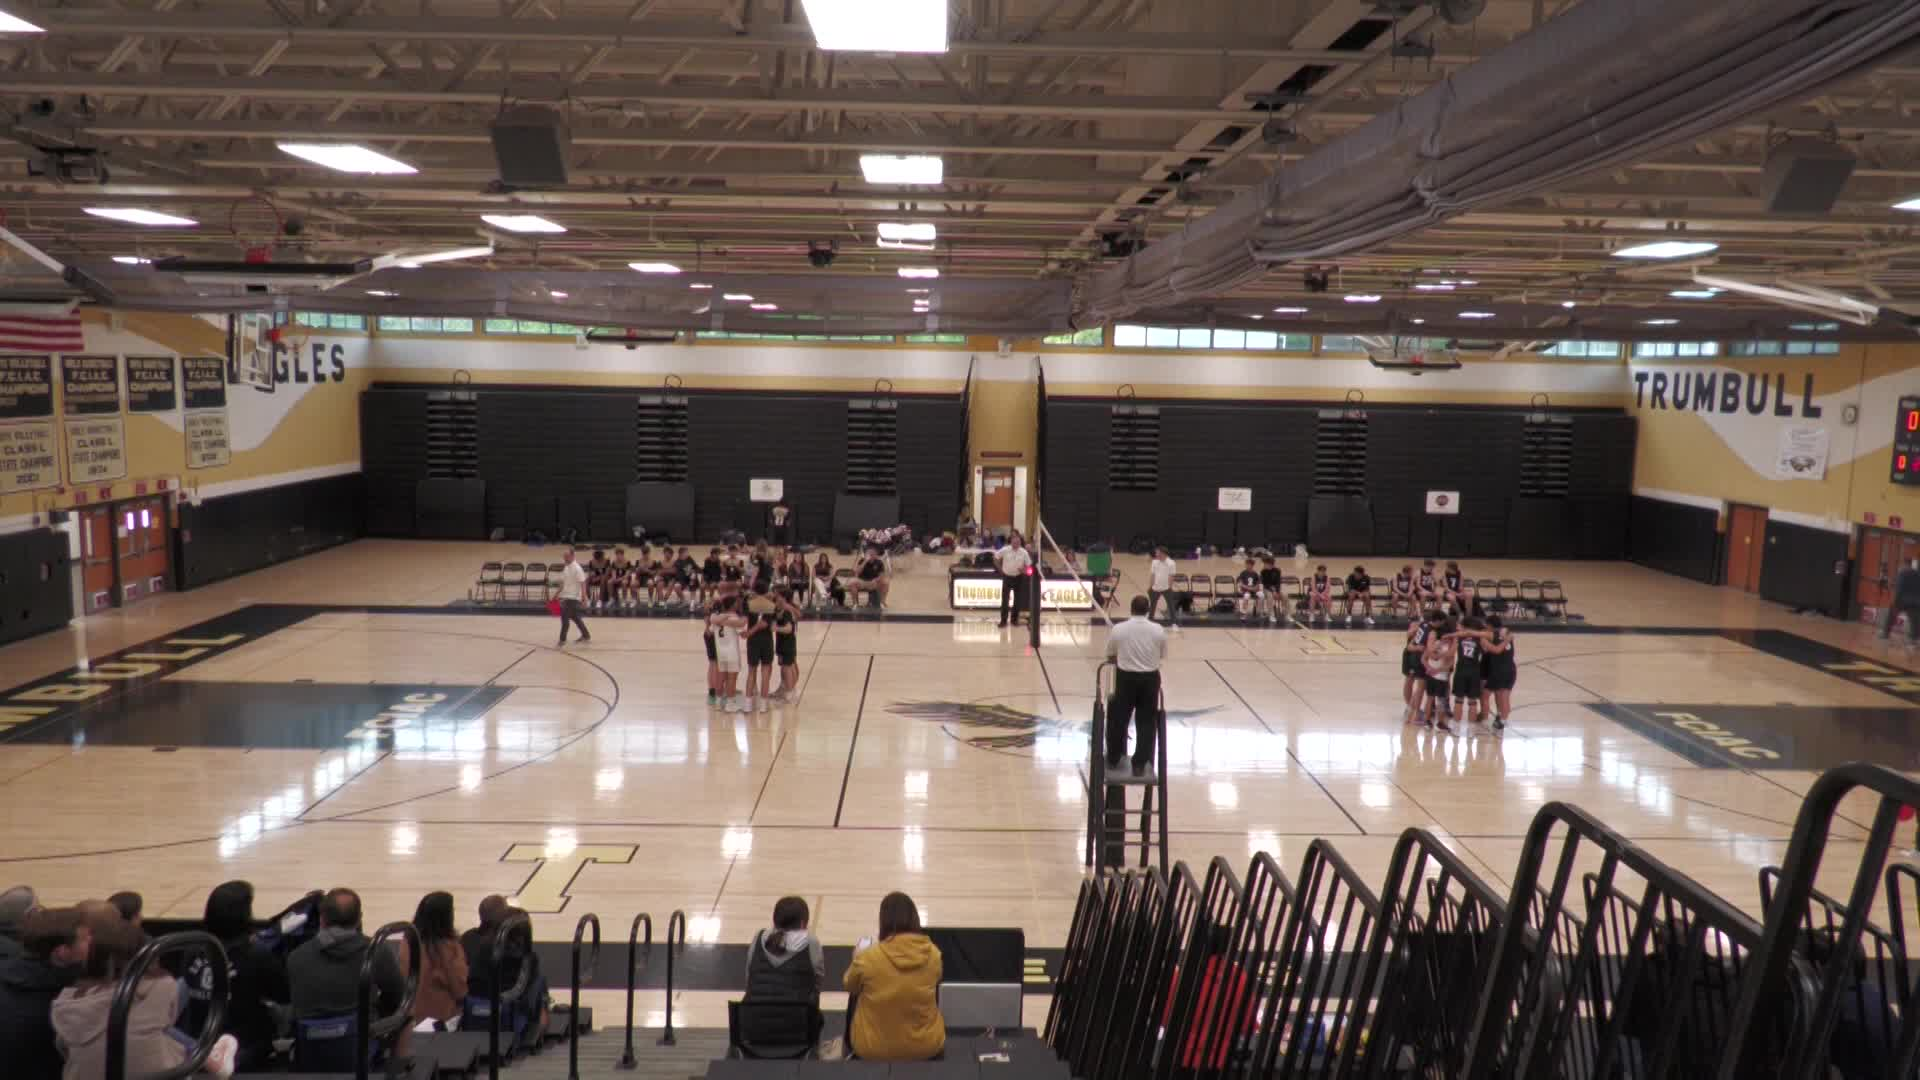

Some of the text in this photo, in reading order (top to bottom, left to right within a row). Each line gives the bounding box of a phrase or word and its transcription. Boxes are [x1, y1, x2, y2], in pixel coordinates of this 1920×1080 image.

[268, 343, 345, 384] GLES
[1635, 371, 1823, 419] TRUMBULL
[956, 586, 1001, 601] TRUMBU
